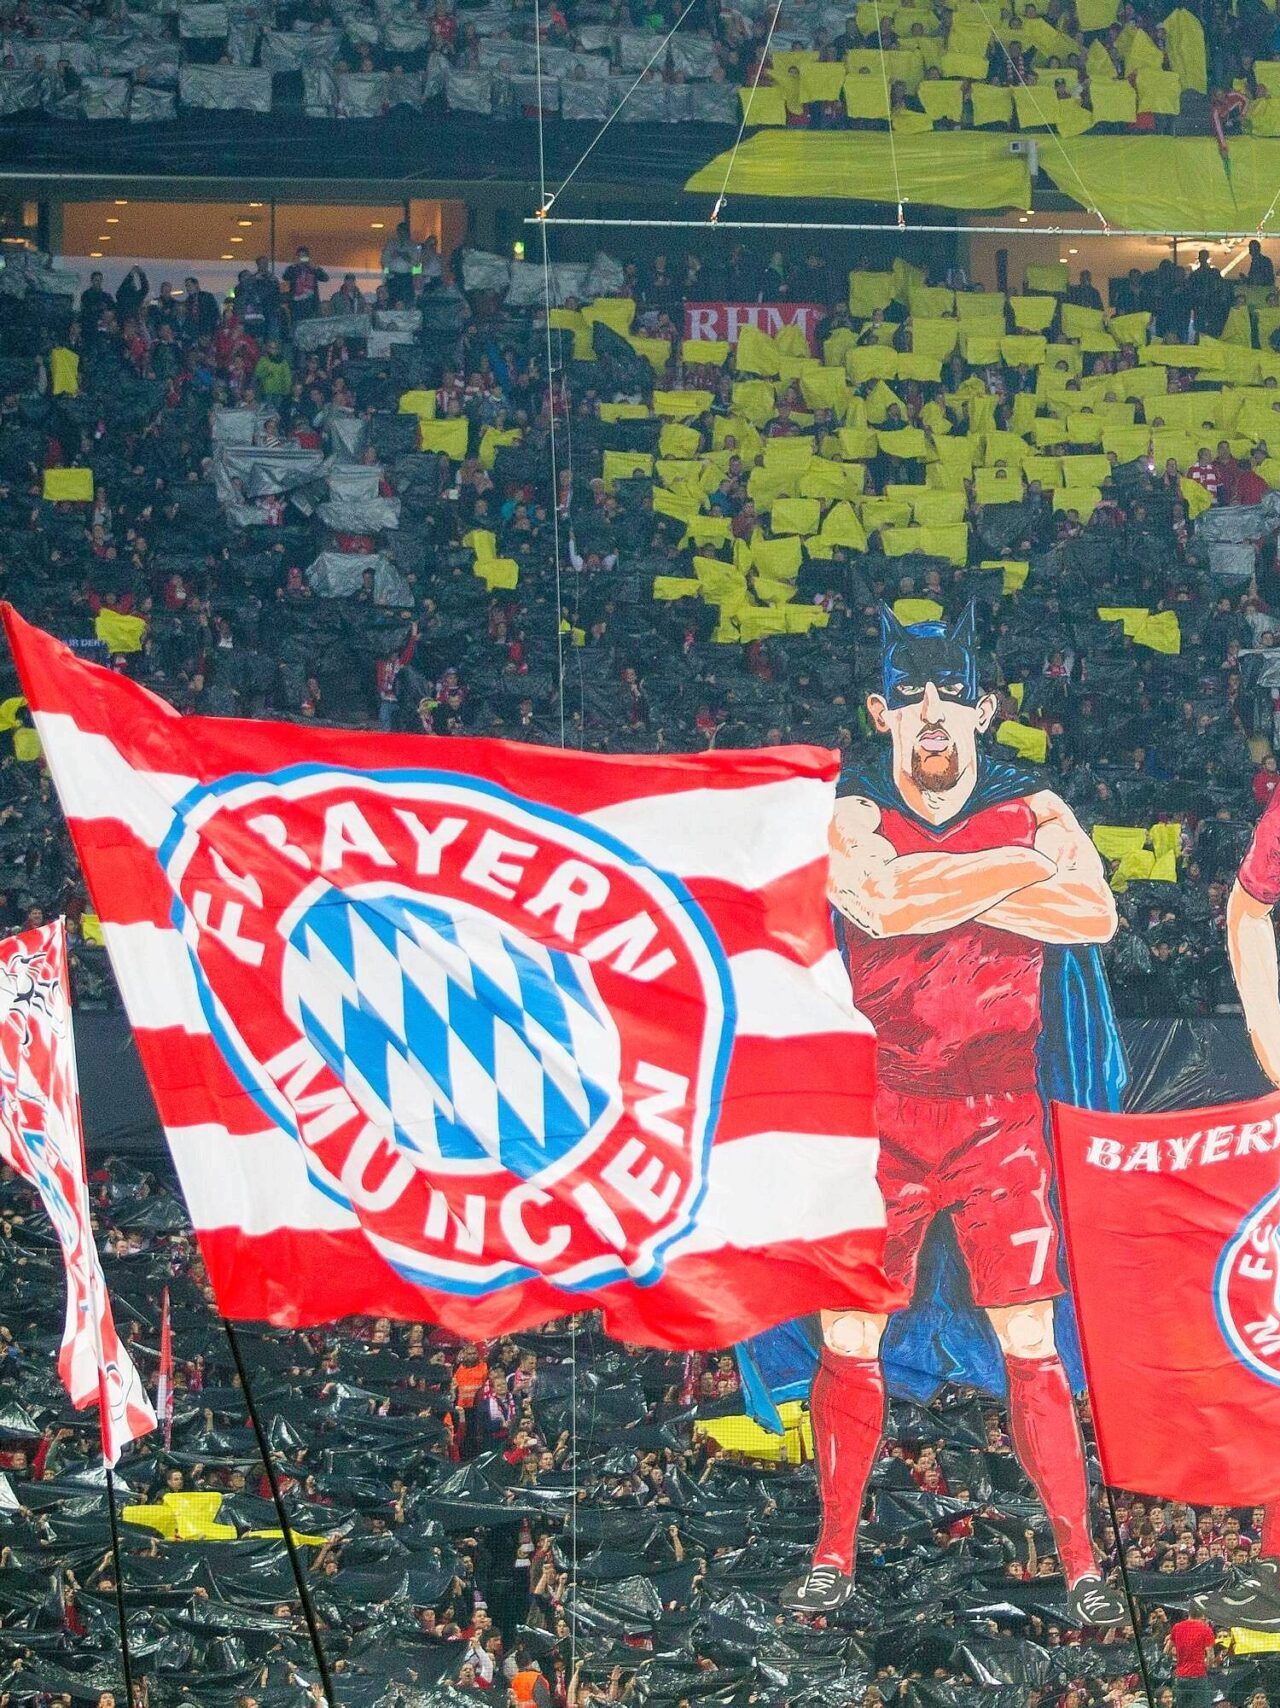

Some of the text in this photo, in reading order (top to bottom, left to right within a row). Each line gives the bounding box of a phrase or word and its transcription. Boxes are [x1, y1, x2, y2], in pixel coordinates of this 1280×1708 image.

[687, 307, 812, 342] RHM
[1010, 1227, 1052, 1286] 7
[1237, 1222, 1275, 1281] FC
